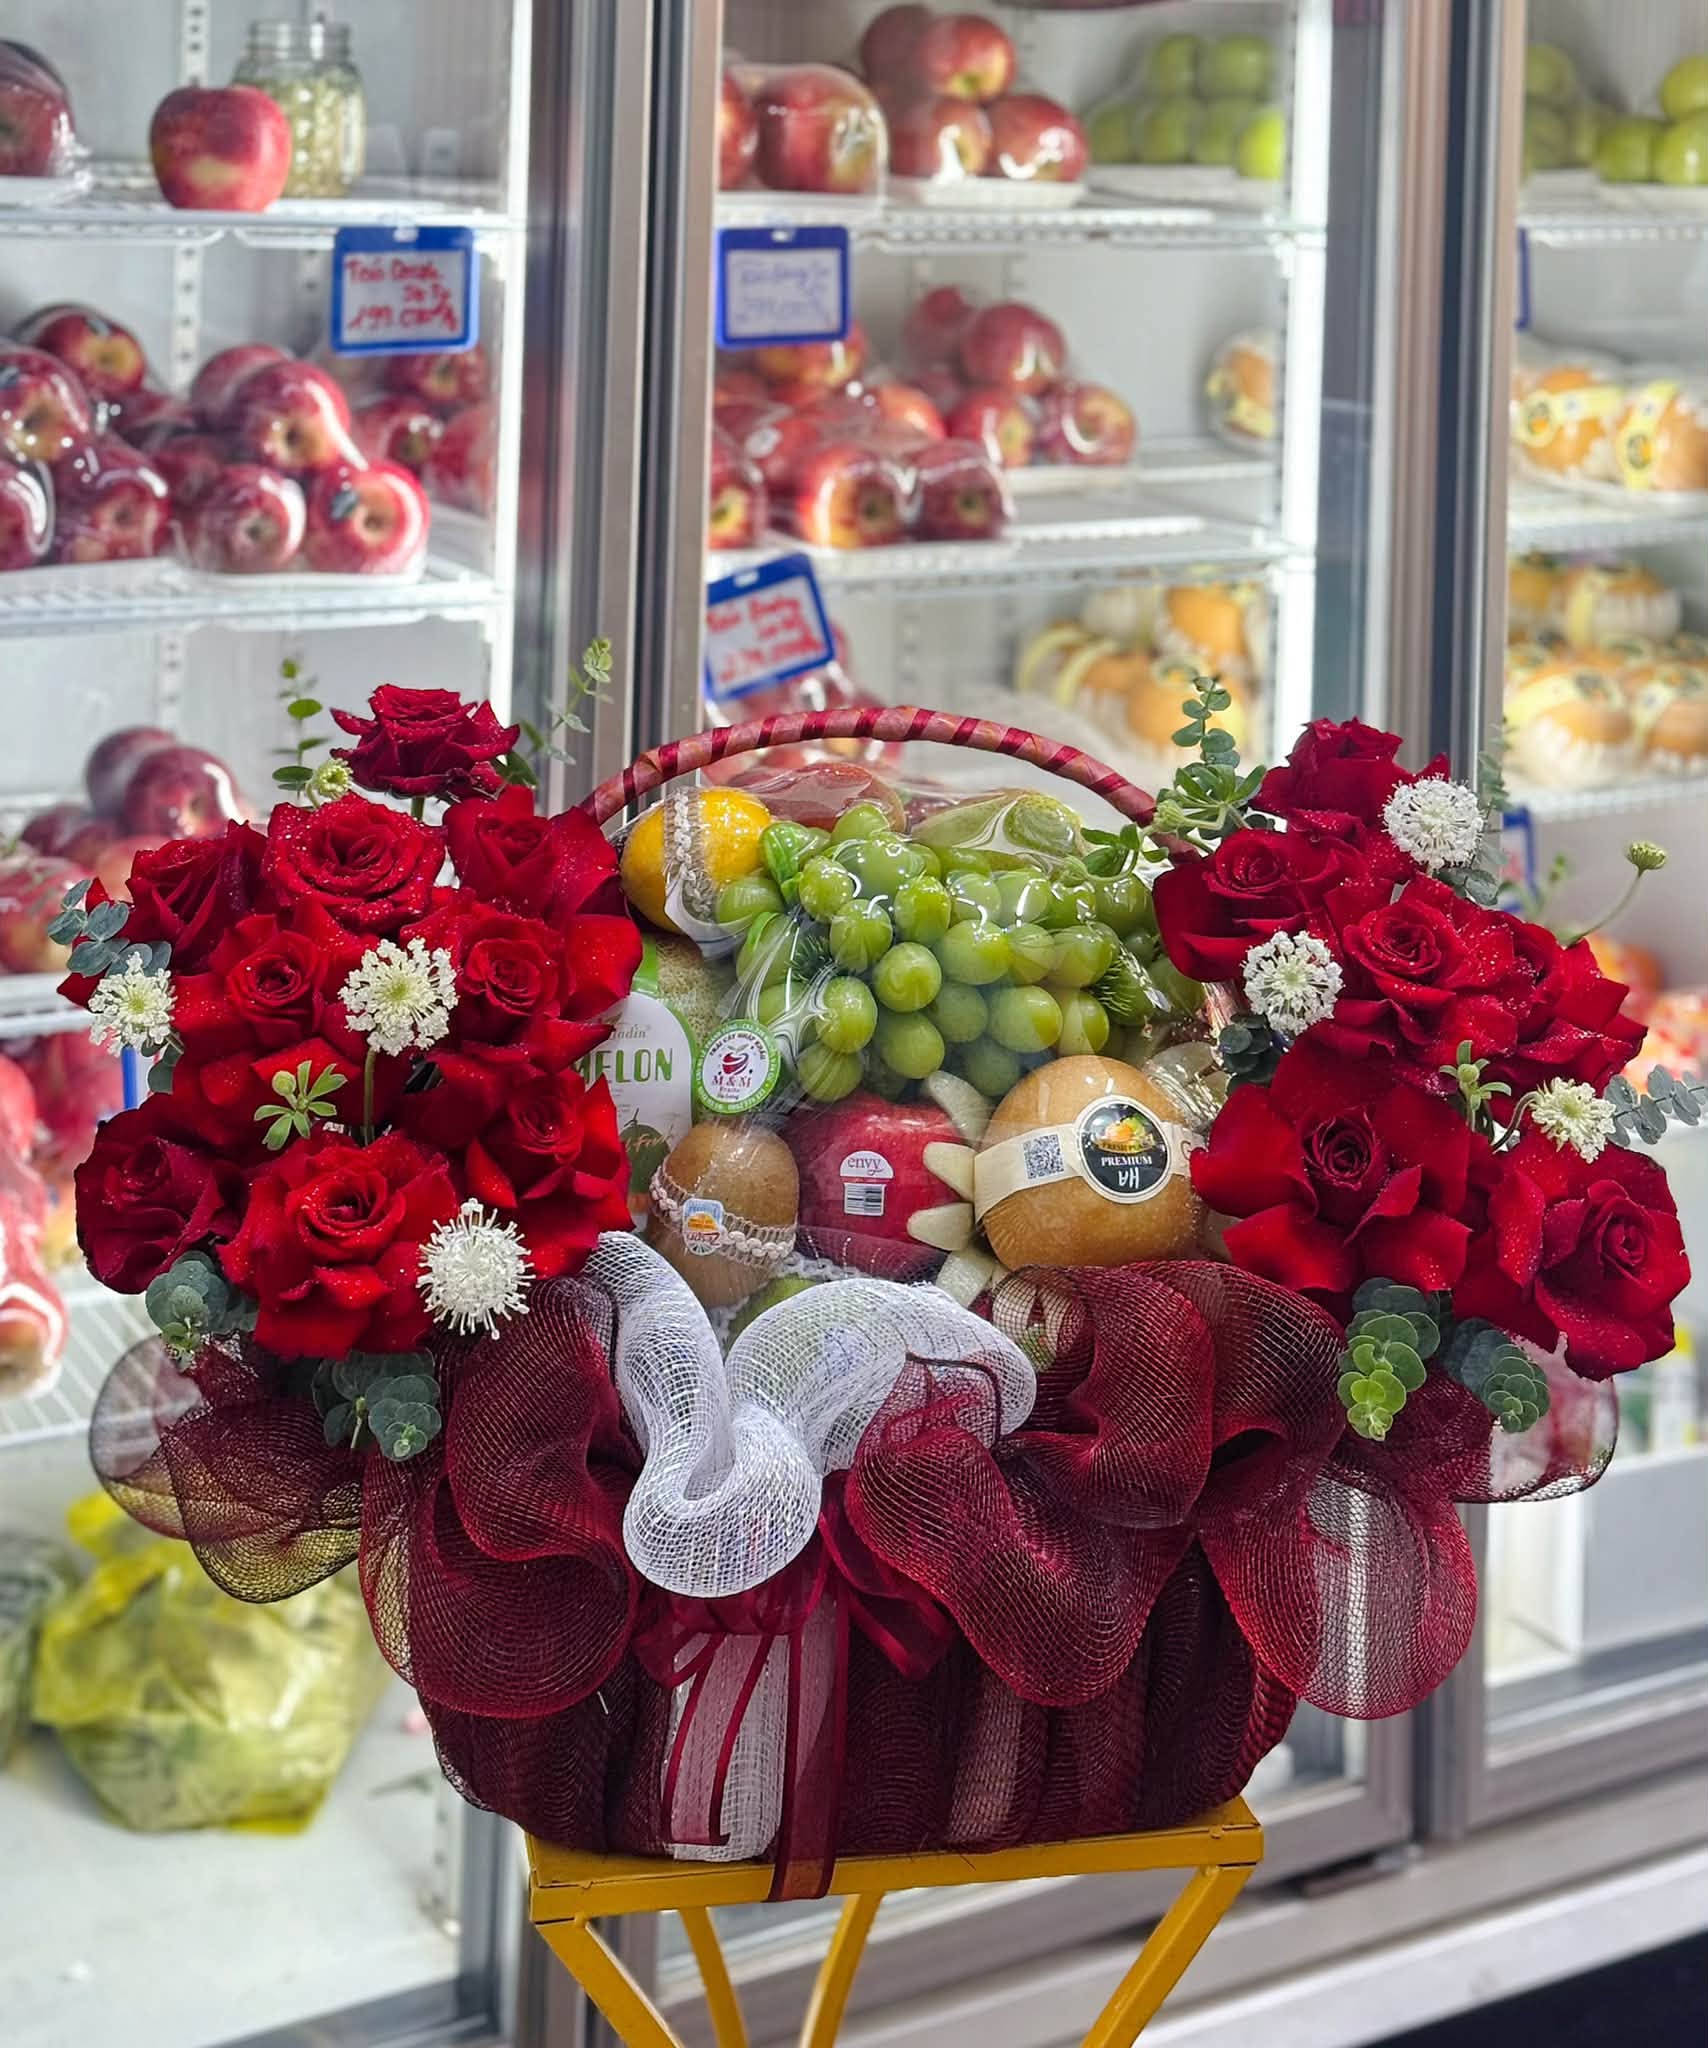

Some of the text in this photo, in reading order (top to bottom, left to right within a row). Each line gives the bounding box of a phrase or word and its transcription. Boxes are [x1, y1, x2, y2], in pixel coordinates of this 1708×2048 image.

[712, 1075, 751, 1088] M & M
[847, 1157, 884, 1176] envy
[1100, 1155, 1153, 1167] PREMIUM
